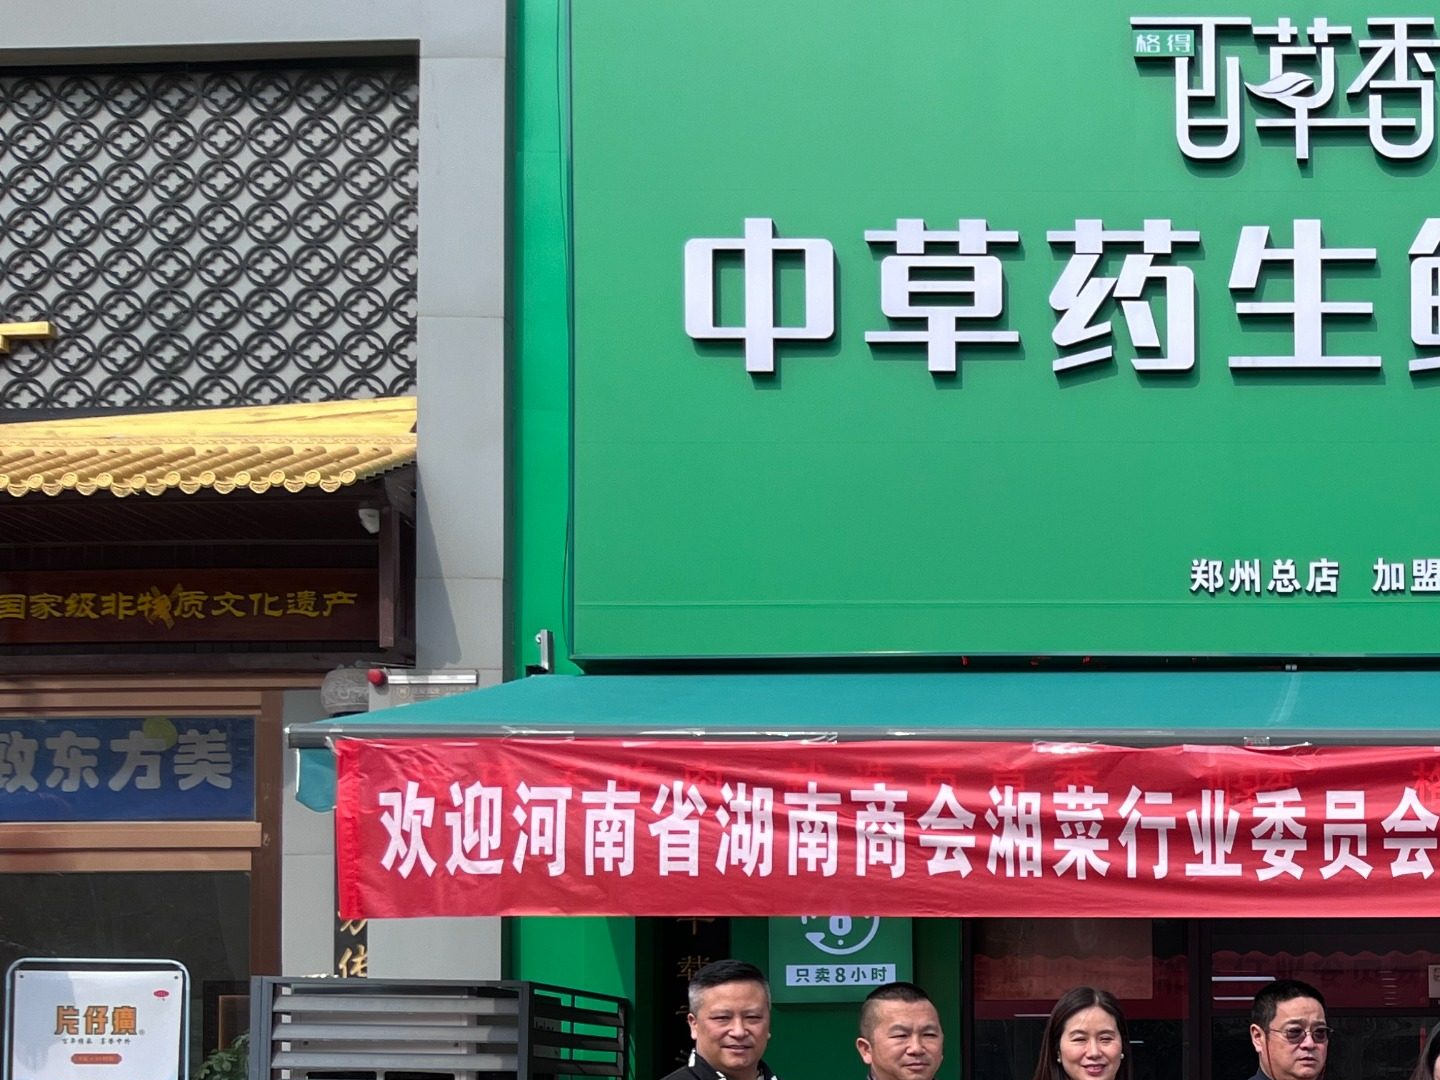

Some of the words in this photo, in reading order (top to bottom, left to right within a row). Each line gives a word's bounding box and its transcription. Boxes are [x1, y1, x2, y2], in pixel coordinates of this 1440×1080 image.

[1135, 34, 1191, 53] 格得
[1190, 558, 1340, 594] 郑州总店
[796, 967, 888, 984] 只卖8小时
